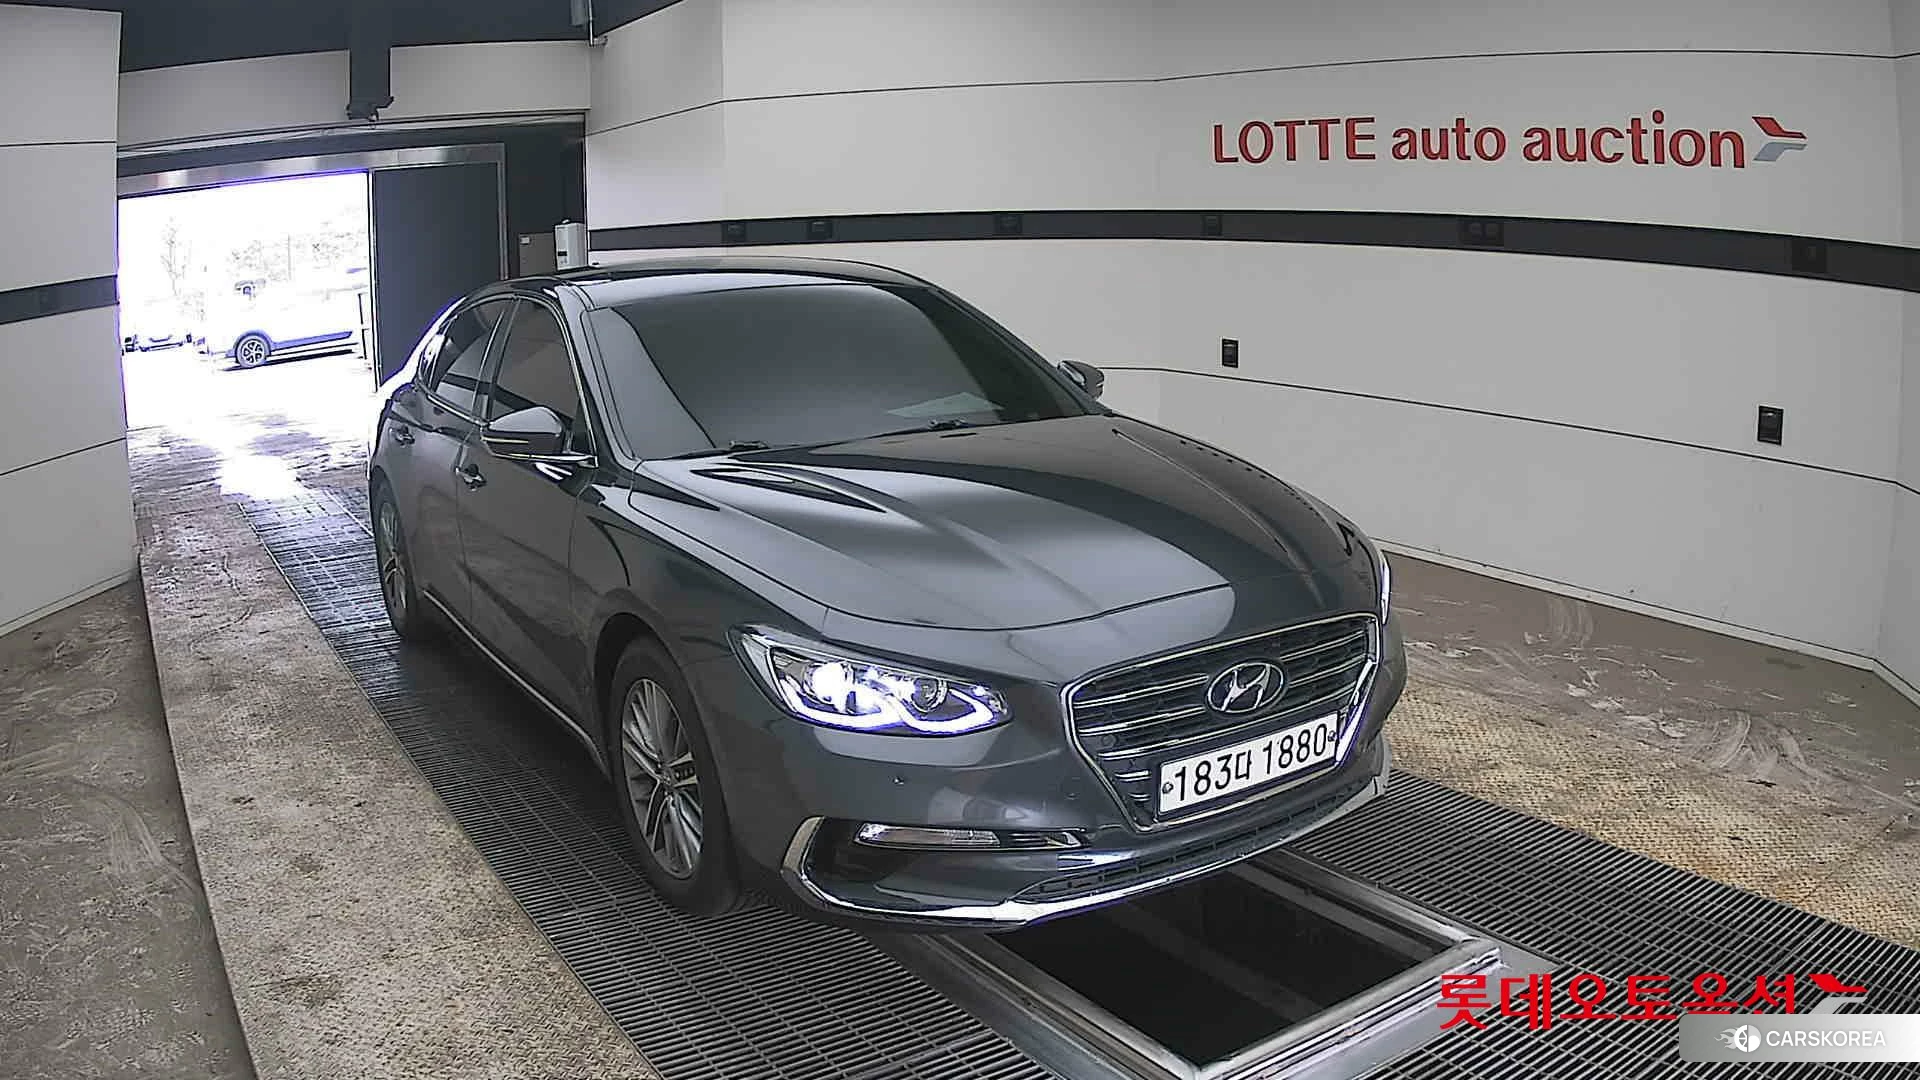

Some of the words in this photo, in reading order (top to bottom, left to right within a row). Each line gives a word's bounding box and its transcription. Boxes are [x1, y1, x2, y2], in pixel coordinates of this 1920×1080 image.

[1212, 116, 1376, 164] LOTTE
[1391, 117, 1507, 162] auto
[1522, 110, 1746, 169] auction
[1174, 750, 1252, 801] 183다
[1263, 723, 1328, 775] 1880
